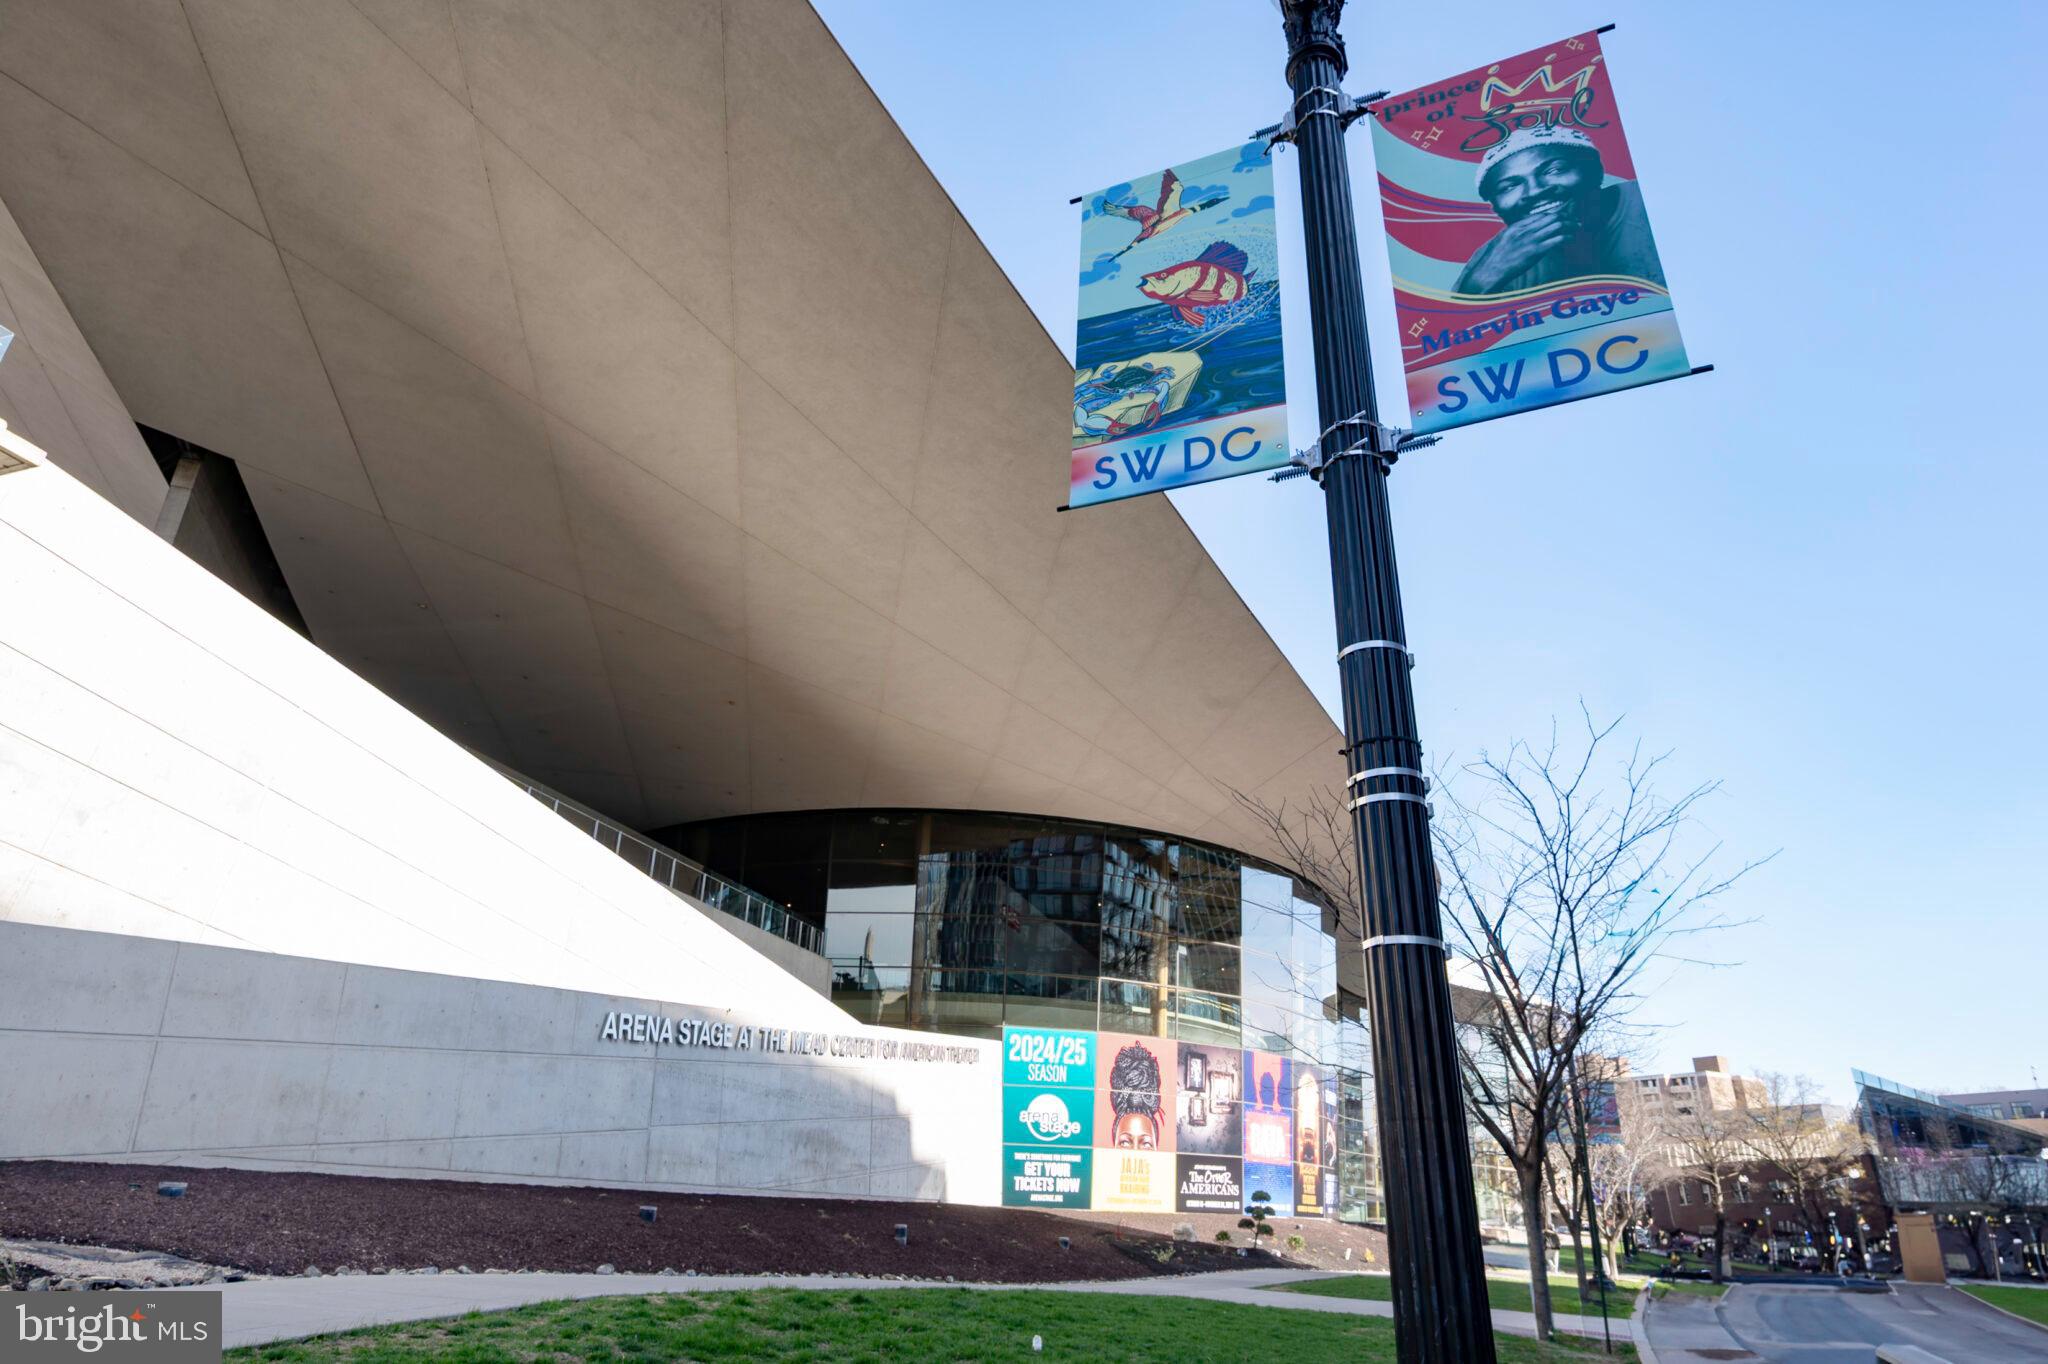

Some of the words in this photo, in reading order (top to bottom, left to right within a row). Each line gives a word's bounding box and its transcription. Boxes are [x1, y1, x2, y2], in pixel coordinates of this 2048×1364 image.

[1383, 79, 1481, 122] prince
[1426, 101, 1457, 122] of
[1460, 87, 1609, 152] Soul
[1422, 309, 1544, 354] Marvin
[1551, 289, 1640, 319] Gaye
[1437, 358, 1525, 414] SW
[1547, 335, 1649, 389] DC
[1093, 443, 1167, 490] SW
[1183, 426, 1262, 472] DC
[602, 1011, 673, 1043] ARENA
[678, 1018, 733, 1048] STAGE
[737, 1026, 756, 1049] AT
[760, 1027, 788, 1052] THE
[790, 1031, 828, 1056] MEAD
[830, 1035, 875, 1058] CENTER
[877, 1039, 899, 1059] FOR
[900, 1041, 945, 1062] AMERICAN
[1009, 1033, 1087, 1065] 2024/25
[1027, 1063, 1067, 1082] SEASON
[1040, 1121, 1081, 1138] stage
[1024, 1161, 1043, 1176] GET
[1044, 1162, 1071, 1178] YOUR
[1189, 1171, 1203, 1182] The
[1014, 1176, 1054, 1192] TICKETS
[1056, 1178, 1080, 1192] NOW
[1180, 1181, 1239, 1196] AMERICANS
